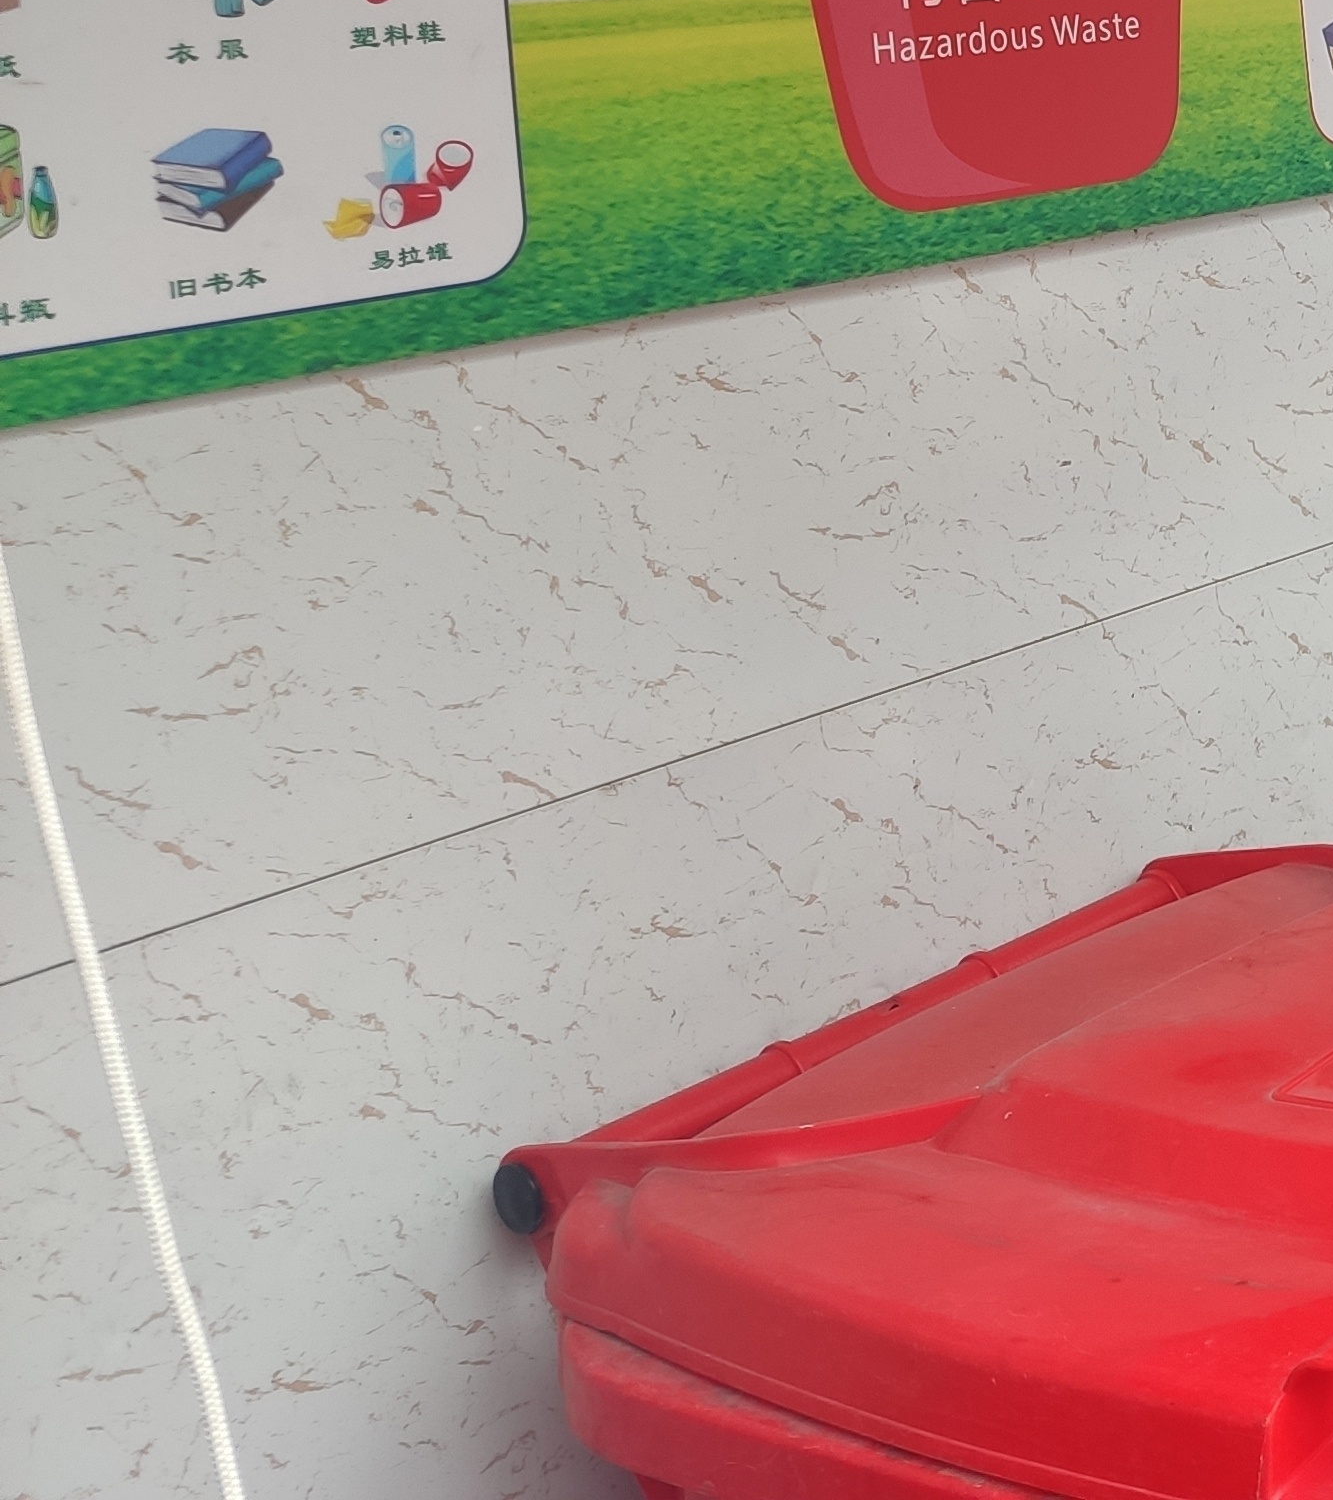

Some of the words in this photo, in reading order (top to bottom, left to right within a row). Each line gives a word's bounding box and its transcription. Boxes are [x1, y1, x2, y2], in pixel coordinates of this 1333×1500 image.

[349, 20, 446, 49] 塑料鞋
[872, 19, 1044, 65] Hazardous
[1050, 11, 1141, 46] Waste
[166, 37, 250, 65] 衣服
[368, 241, 453, 272] 易拉罐
[168, 267, 268, 300] 旧书本
